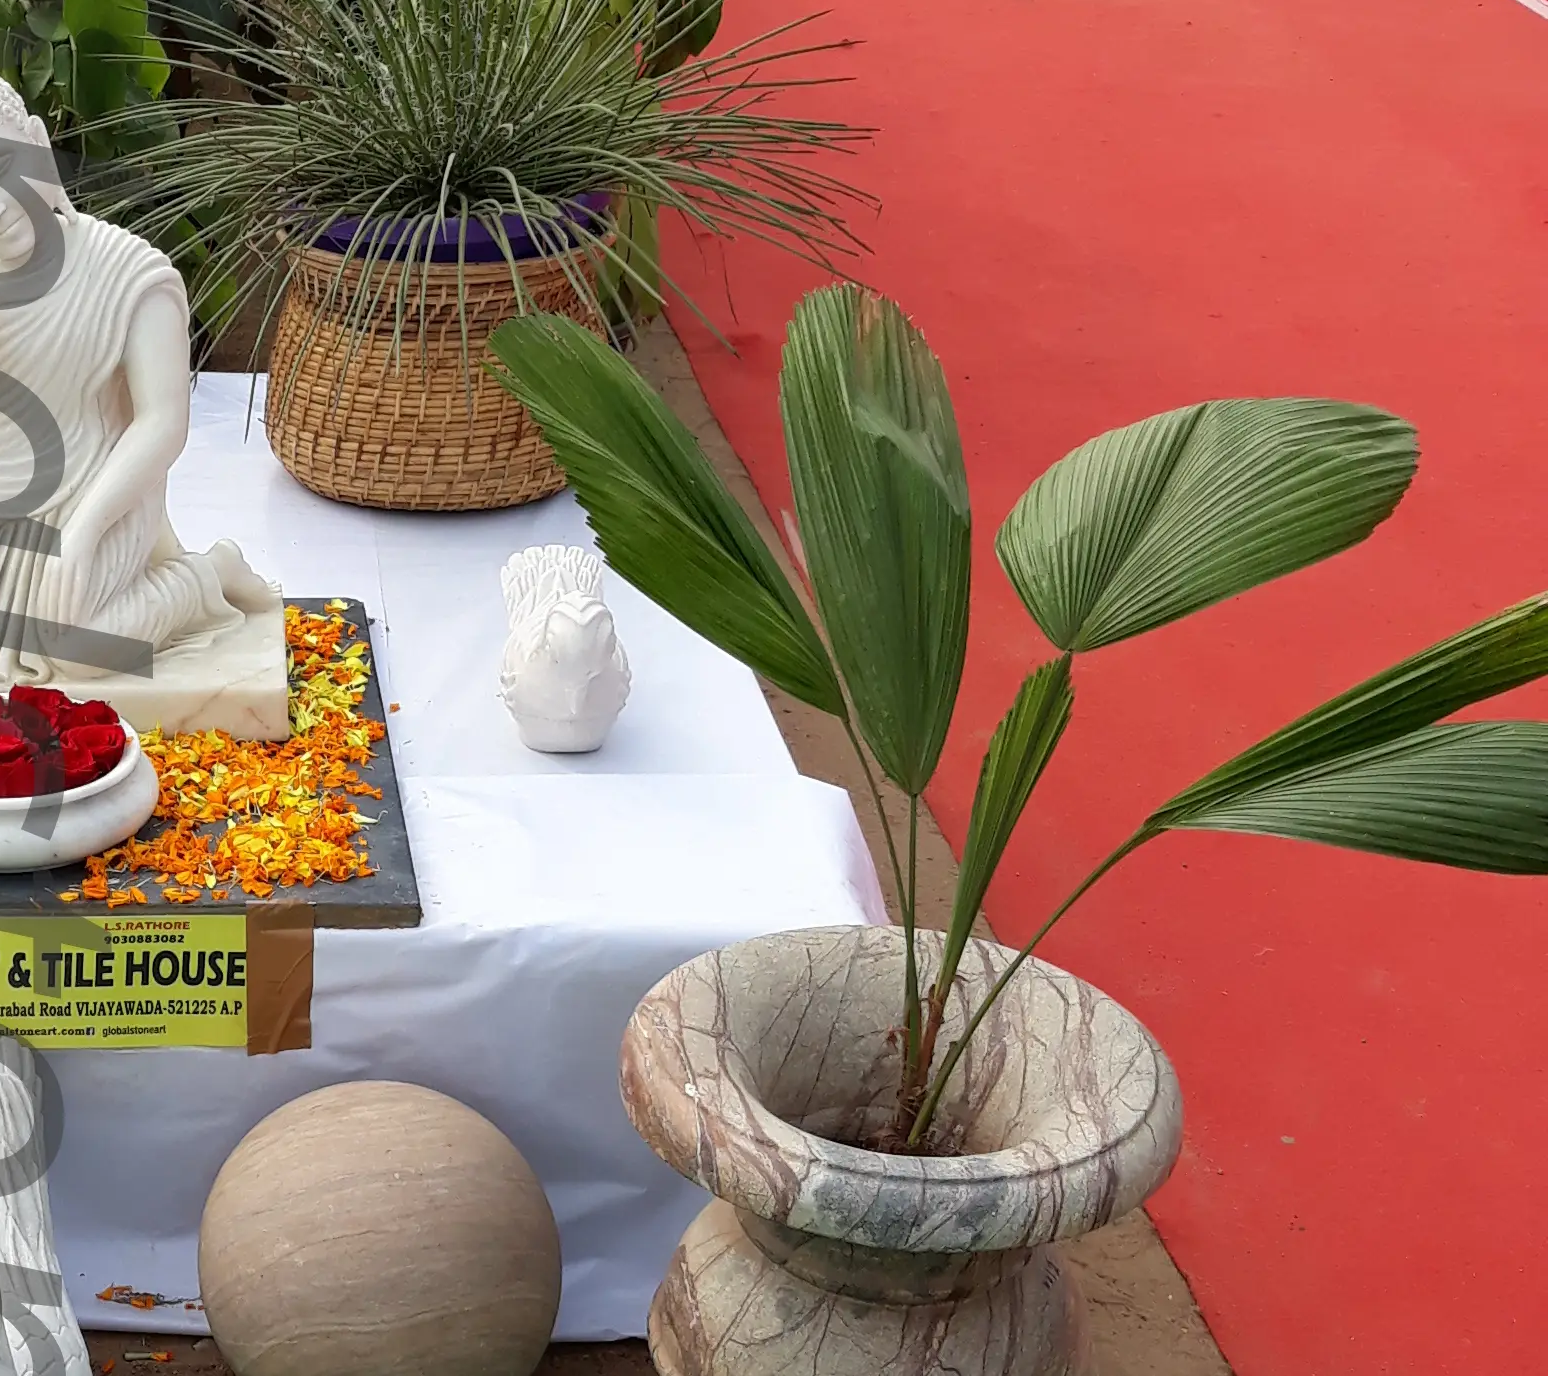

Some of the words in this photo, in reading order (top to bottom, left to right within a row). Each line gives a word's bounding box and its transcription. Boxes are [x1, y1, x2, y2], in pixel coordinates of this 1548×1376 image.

[104, 920, 191, 931] L.S.RATHORE
[104, 933, 185, 944] 9030883082
[7, 951, 33, 988] &
[41, 951, 115, 988] TILE
[125, 950, 247, 987] HOUSE
[39, 1002, 72, 1017] Road
[76, 1000, 217, 1017] VIJAYAWADA-521225
[220, 1003, 243, 1016] A.P
